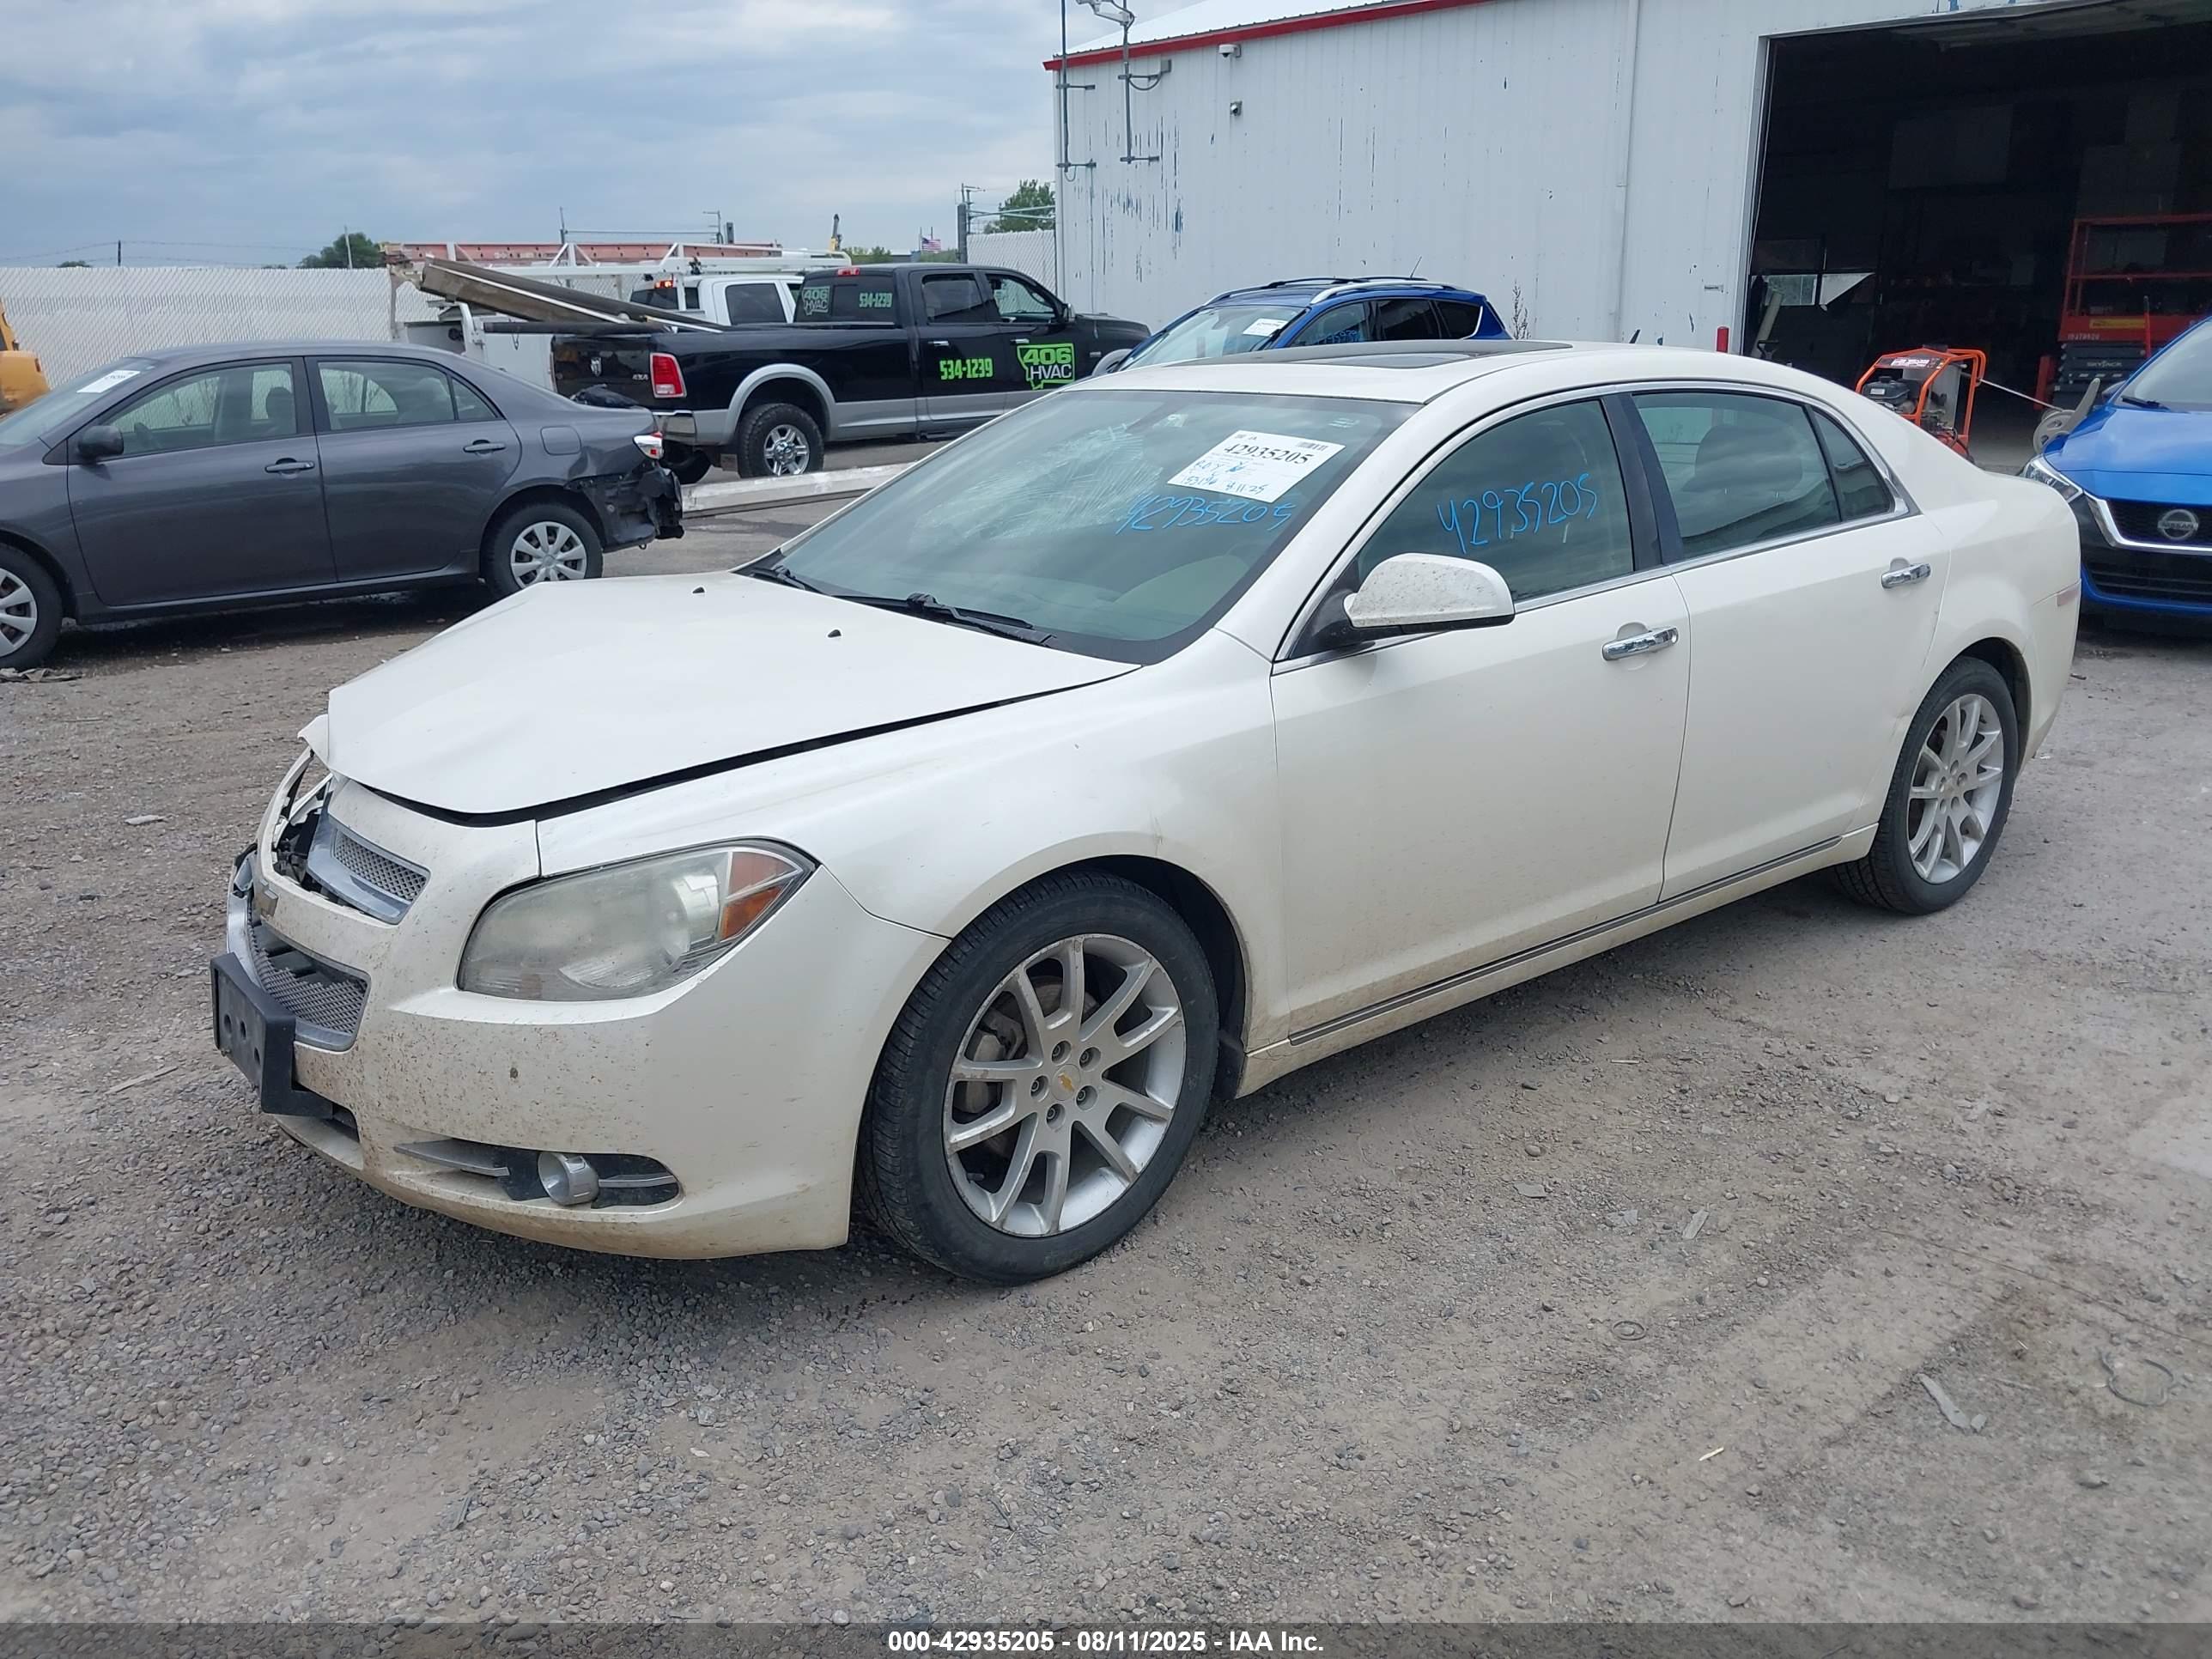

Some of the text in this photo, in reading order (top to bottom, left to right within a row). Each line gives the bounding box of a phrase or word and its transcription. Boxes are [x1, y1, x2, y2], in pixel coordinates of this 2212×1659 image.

[804, 289, 828, 301] 406
[859, 293, 893, 307] 534-1239
[805, 299, 829, 311] HVAC
[1023, 348, 1072, 365] 406
[939, 358, 994, 380] 534-1239
[1030, 363, 1073, 380] HVAC
[1224, 443, 1314, 465] 42935205
[1116, 495, 1296, 535] 42935205
[1437, 473, 1596, 554] 42935205
